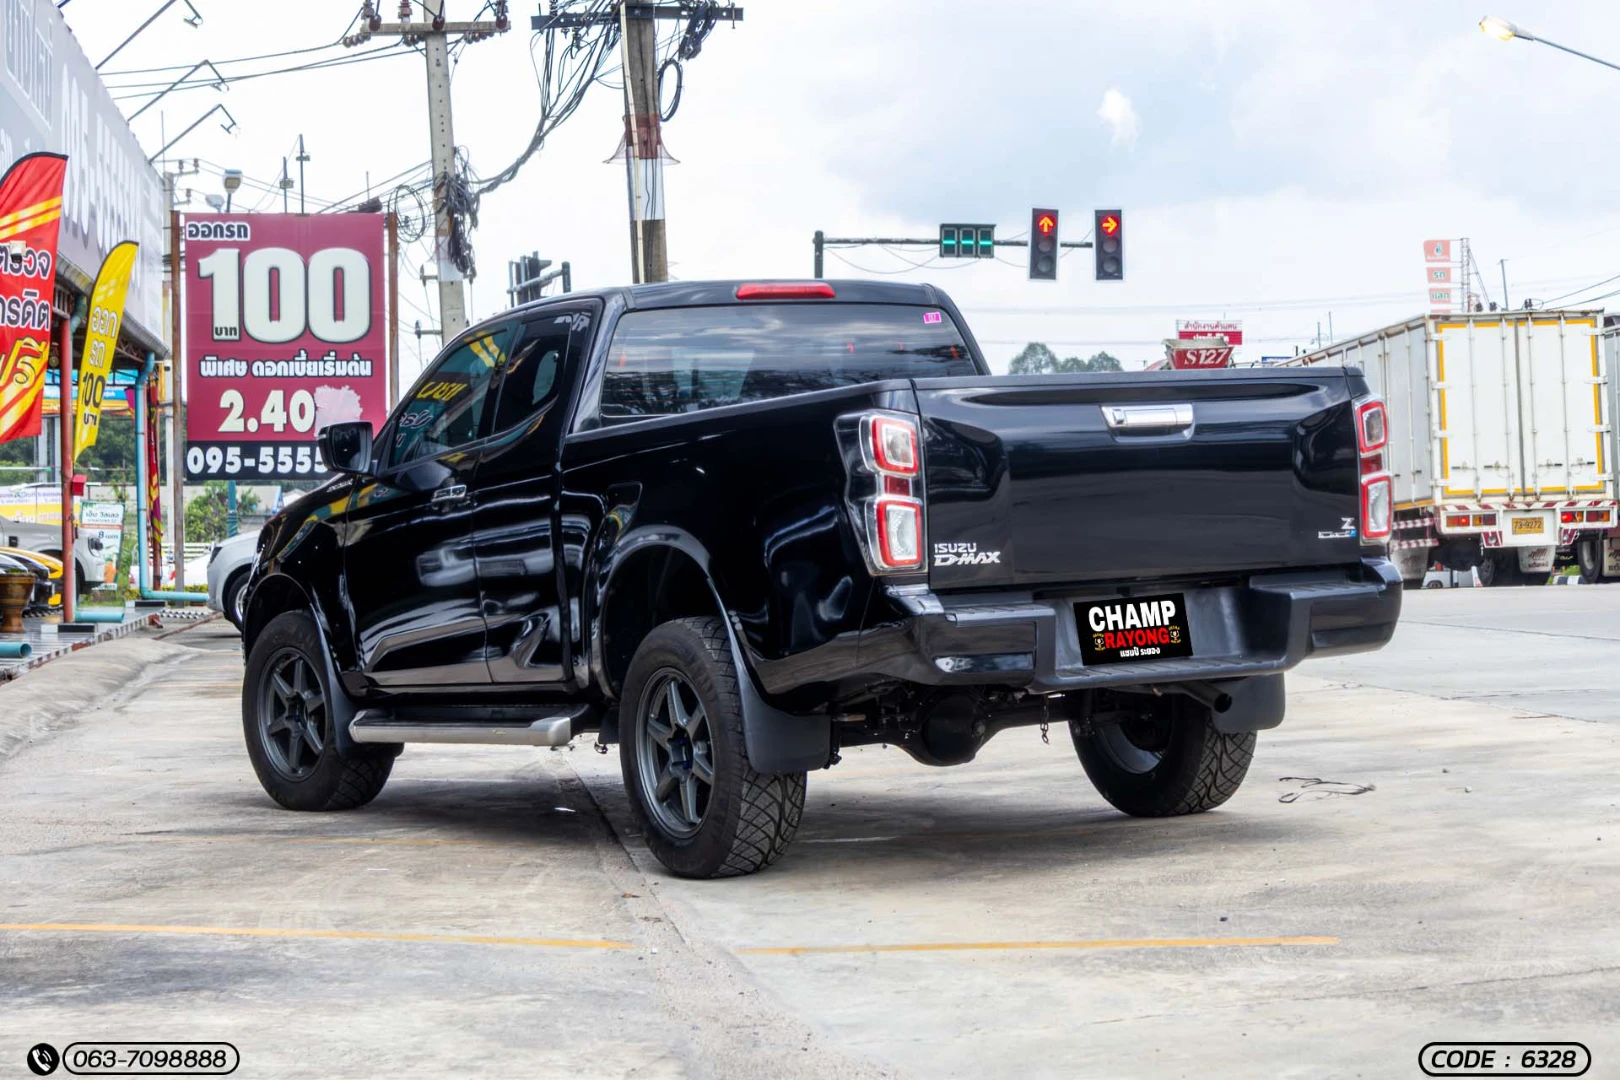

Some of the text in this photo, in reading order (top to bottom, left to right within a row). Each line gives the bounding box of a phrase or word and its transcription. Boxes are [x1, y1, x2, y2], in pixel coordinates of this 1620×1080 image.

[187, 223, 249, 239] ออกรถ
[198, 247, 372, 344] 100
[92, 306, 118, 338] ออก
[214, 326, 238, 337] บาท
[199, 349, 373, 377] พิเศษ ดอกเบี้ยเริ่มต้น
[81, 371, 106, 408] 100
[218, 389, 316, 433] 2.40
[1340, 517, 1356, 530] Z
[934, 542, 977, 553] ISUZU
[934, 551, 1001, 566] D-MAX
